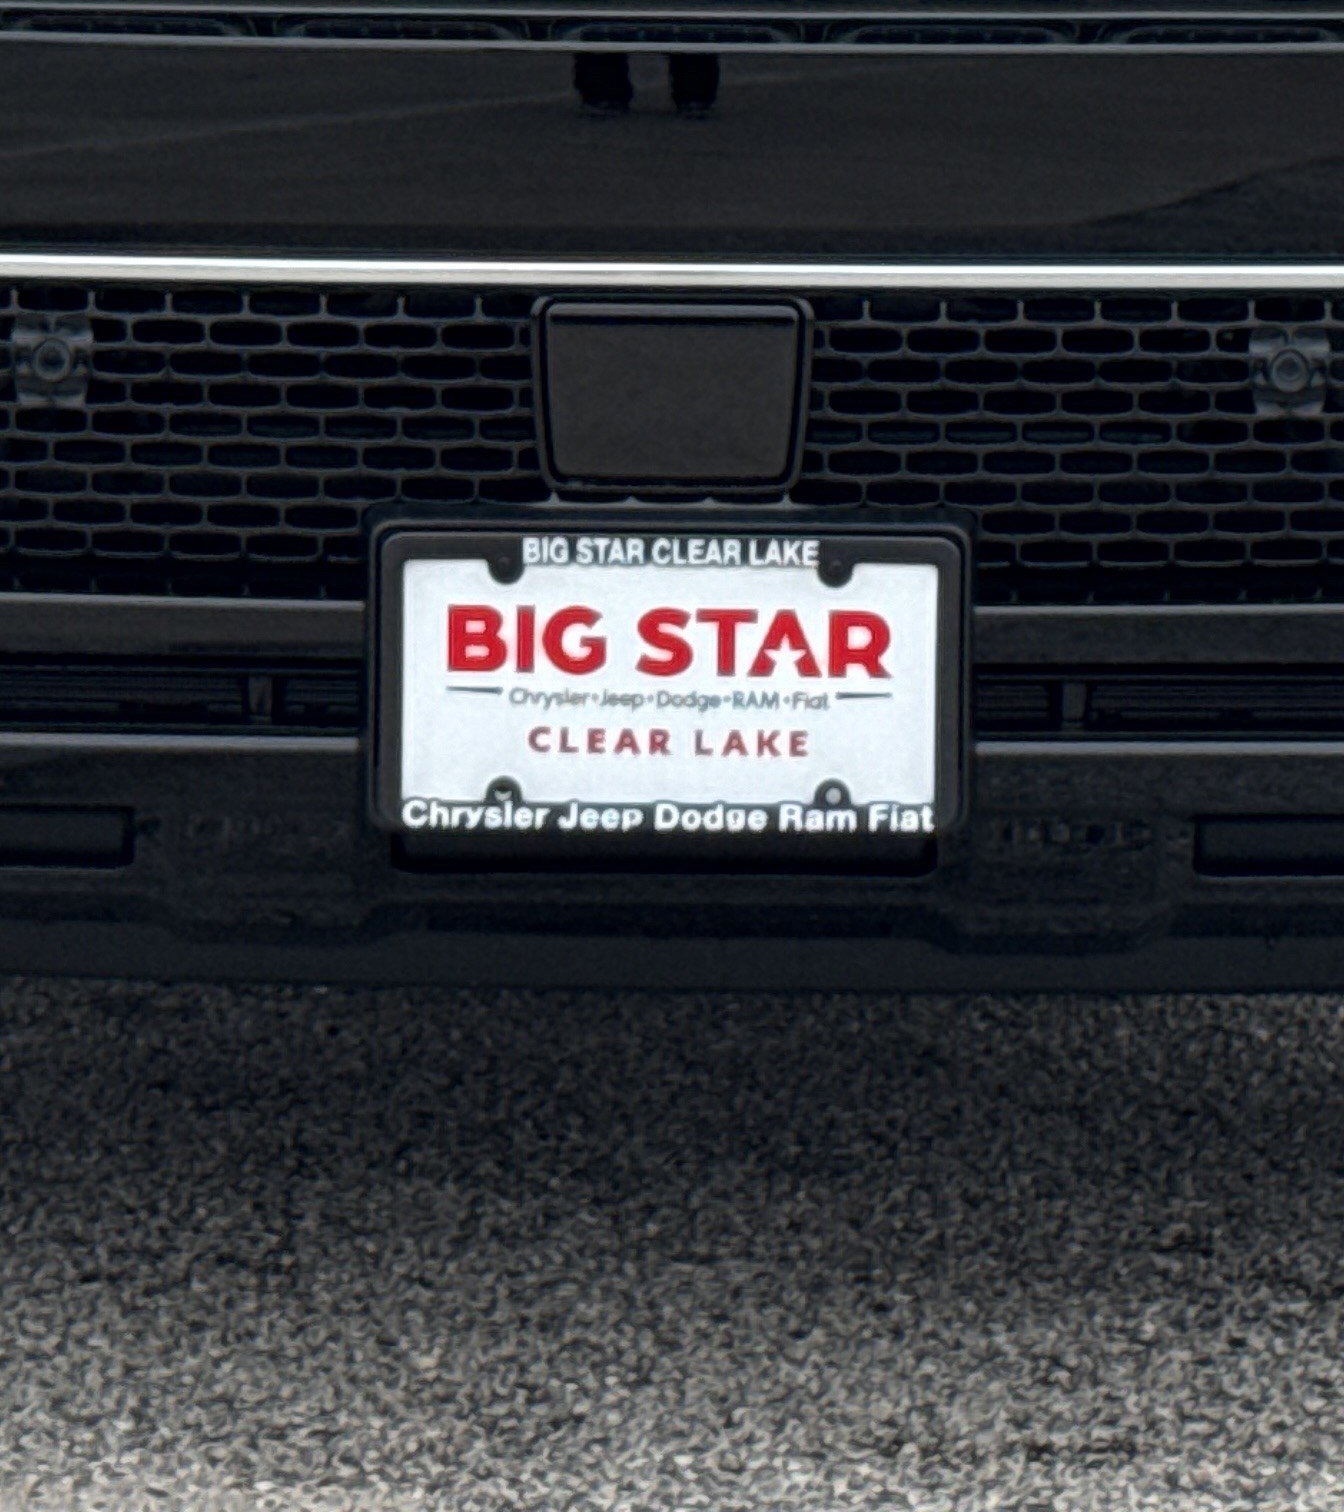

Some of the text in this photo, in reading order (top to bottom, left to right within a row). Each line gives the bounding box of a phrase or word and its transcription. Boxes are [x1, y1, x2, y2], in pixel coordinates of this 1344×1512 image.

[522, 538, 820, 567] BIG STAR CLEAR LAKE
[447, 604, 892, 679] BIG STAR
[528, 726, 809, 758] CLEAR LAKE
[401, 800, 935, 834] Chrysler Jeep Dodge Ram Fiat
